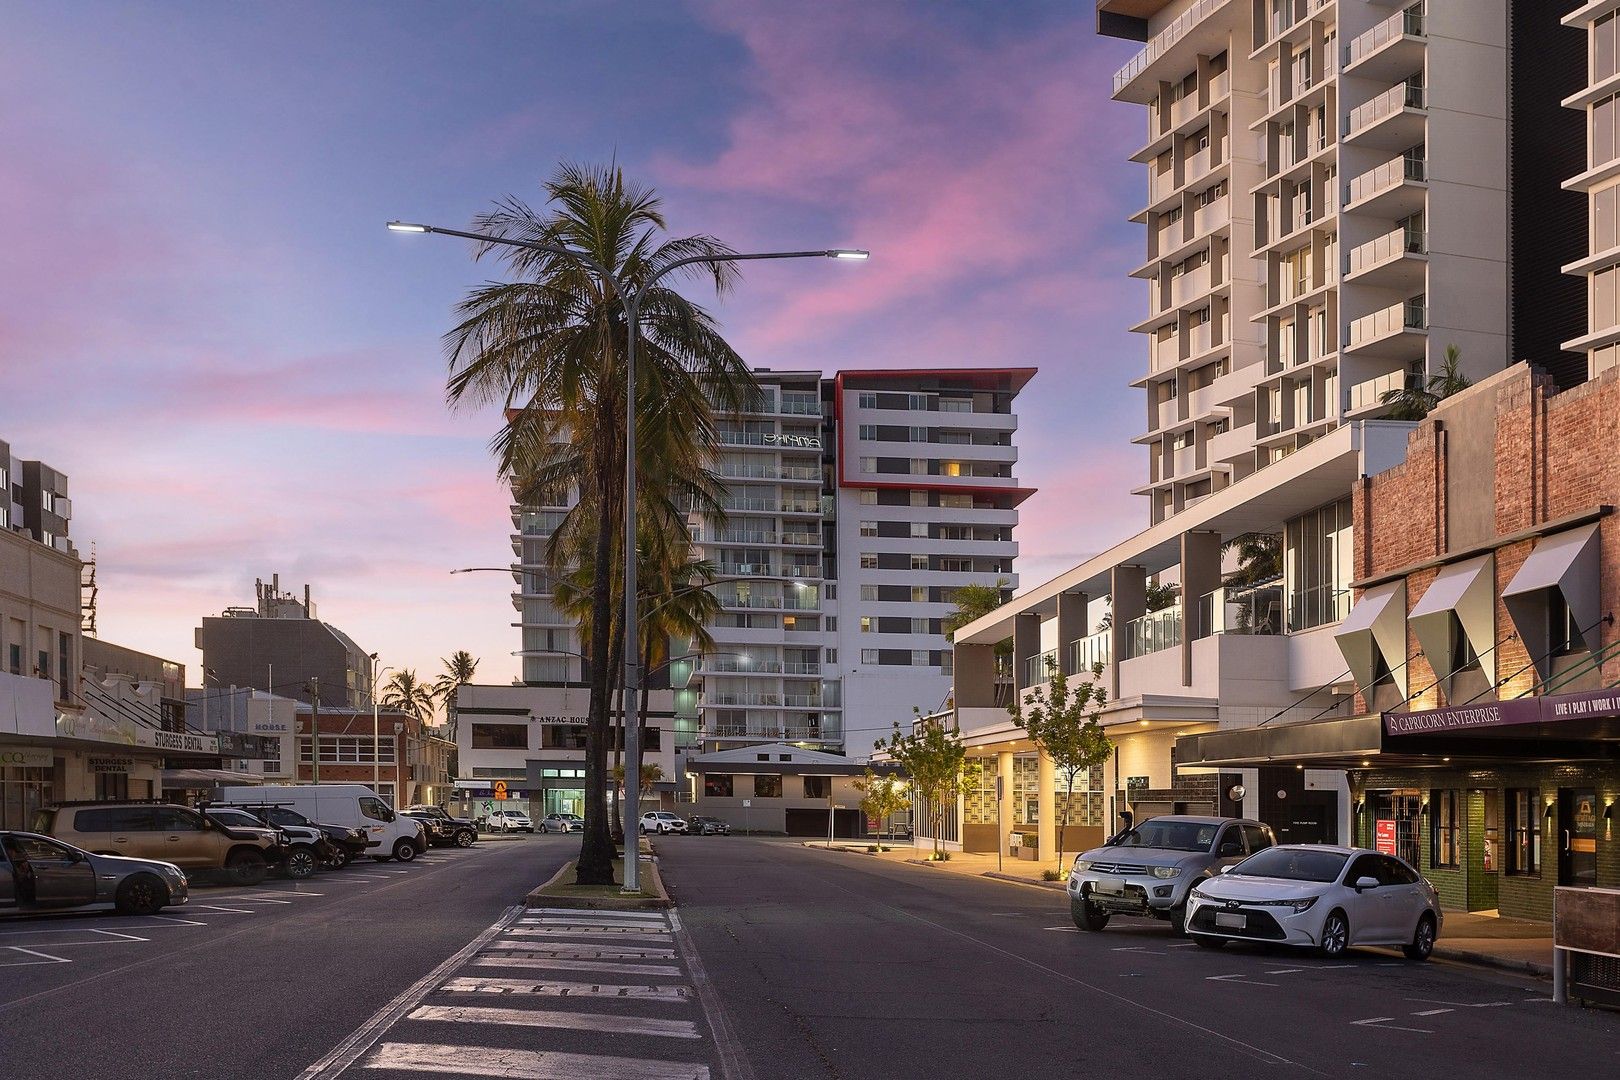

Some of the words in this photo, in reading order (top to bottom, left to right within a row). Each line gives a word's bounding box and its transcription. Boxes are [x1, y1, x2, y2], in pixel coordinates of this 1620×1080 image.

[1555, 703, 1568, 715] LIVE
[1572, 701, 1586, 713] PLAY
[1592, 698, 1611, 711] WORK
[1399, 713, 1445, 731] CAPRICORN
[1446, 707, 1501, 726] ENTERPRISE
[154, 732, 183, 749] STURGESS
[184, 736, 203, 751] DENTAL
